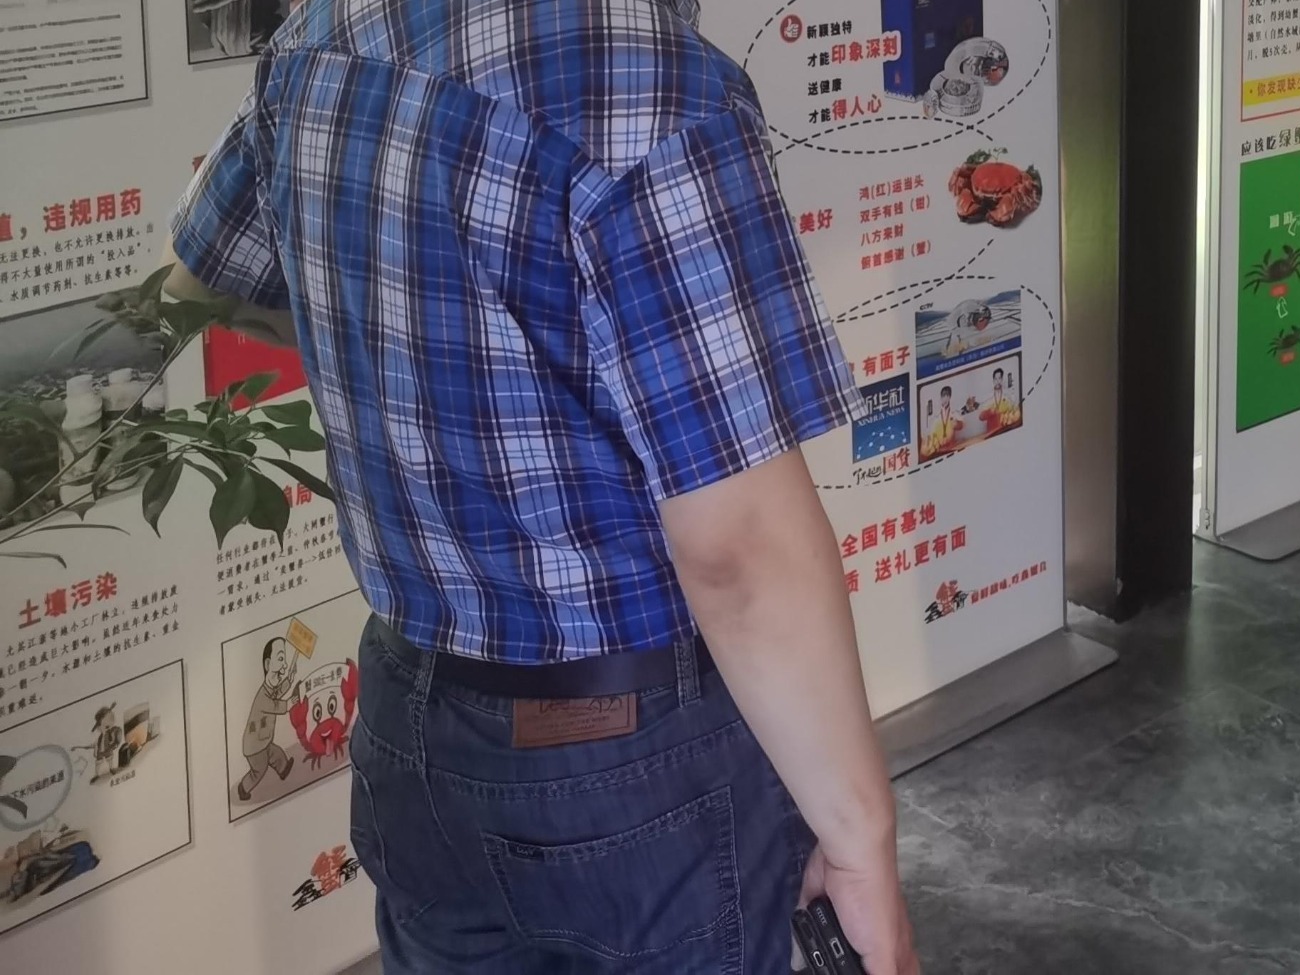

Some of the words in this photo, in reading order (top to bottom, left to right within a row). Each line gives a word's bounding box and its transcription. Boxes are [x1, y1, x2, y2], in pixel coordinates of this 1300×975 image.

[806, 20, 852, 39] 新颖独特
[807, 35, 899, 68] 才能印象深刻
[808, 78, 843, 97] 送健康
[808, 94, 883, 124] 才能得人心
[799, 208, 834, 235] 美好
[860, 224, 904, 247] 八方来财
[863, 346, 911, 377] 有面子
[841, 501, 936, 559] 全国有基地
[874, 526, 967, 583] 送礼更有面
[18, 571, 118, 629] 土壤污染
